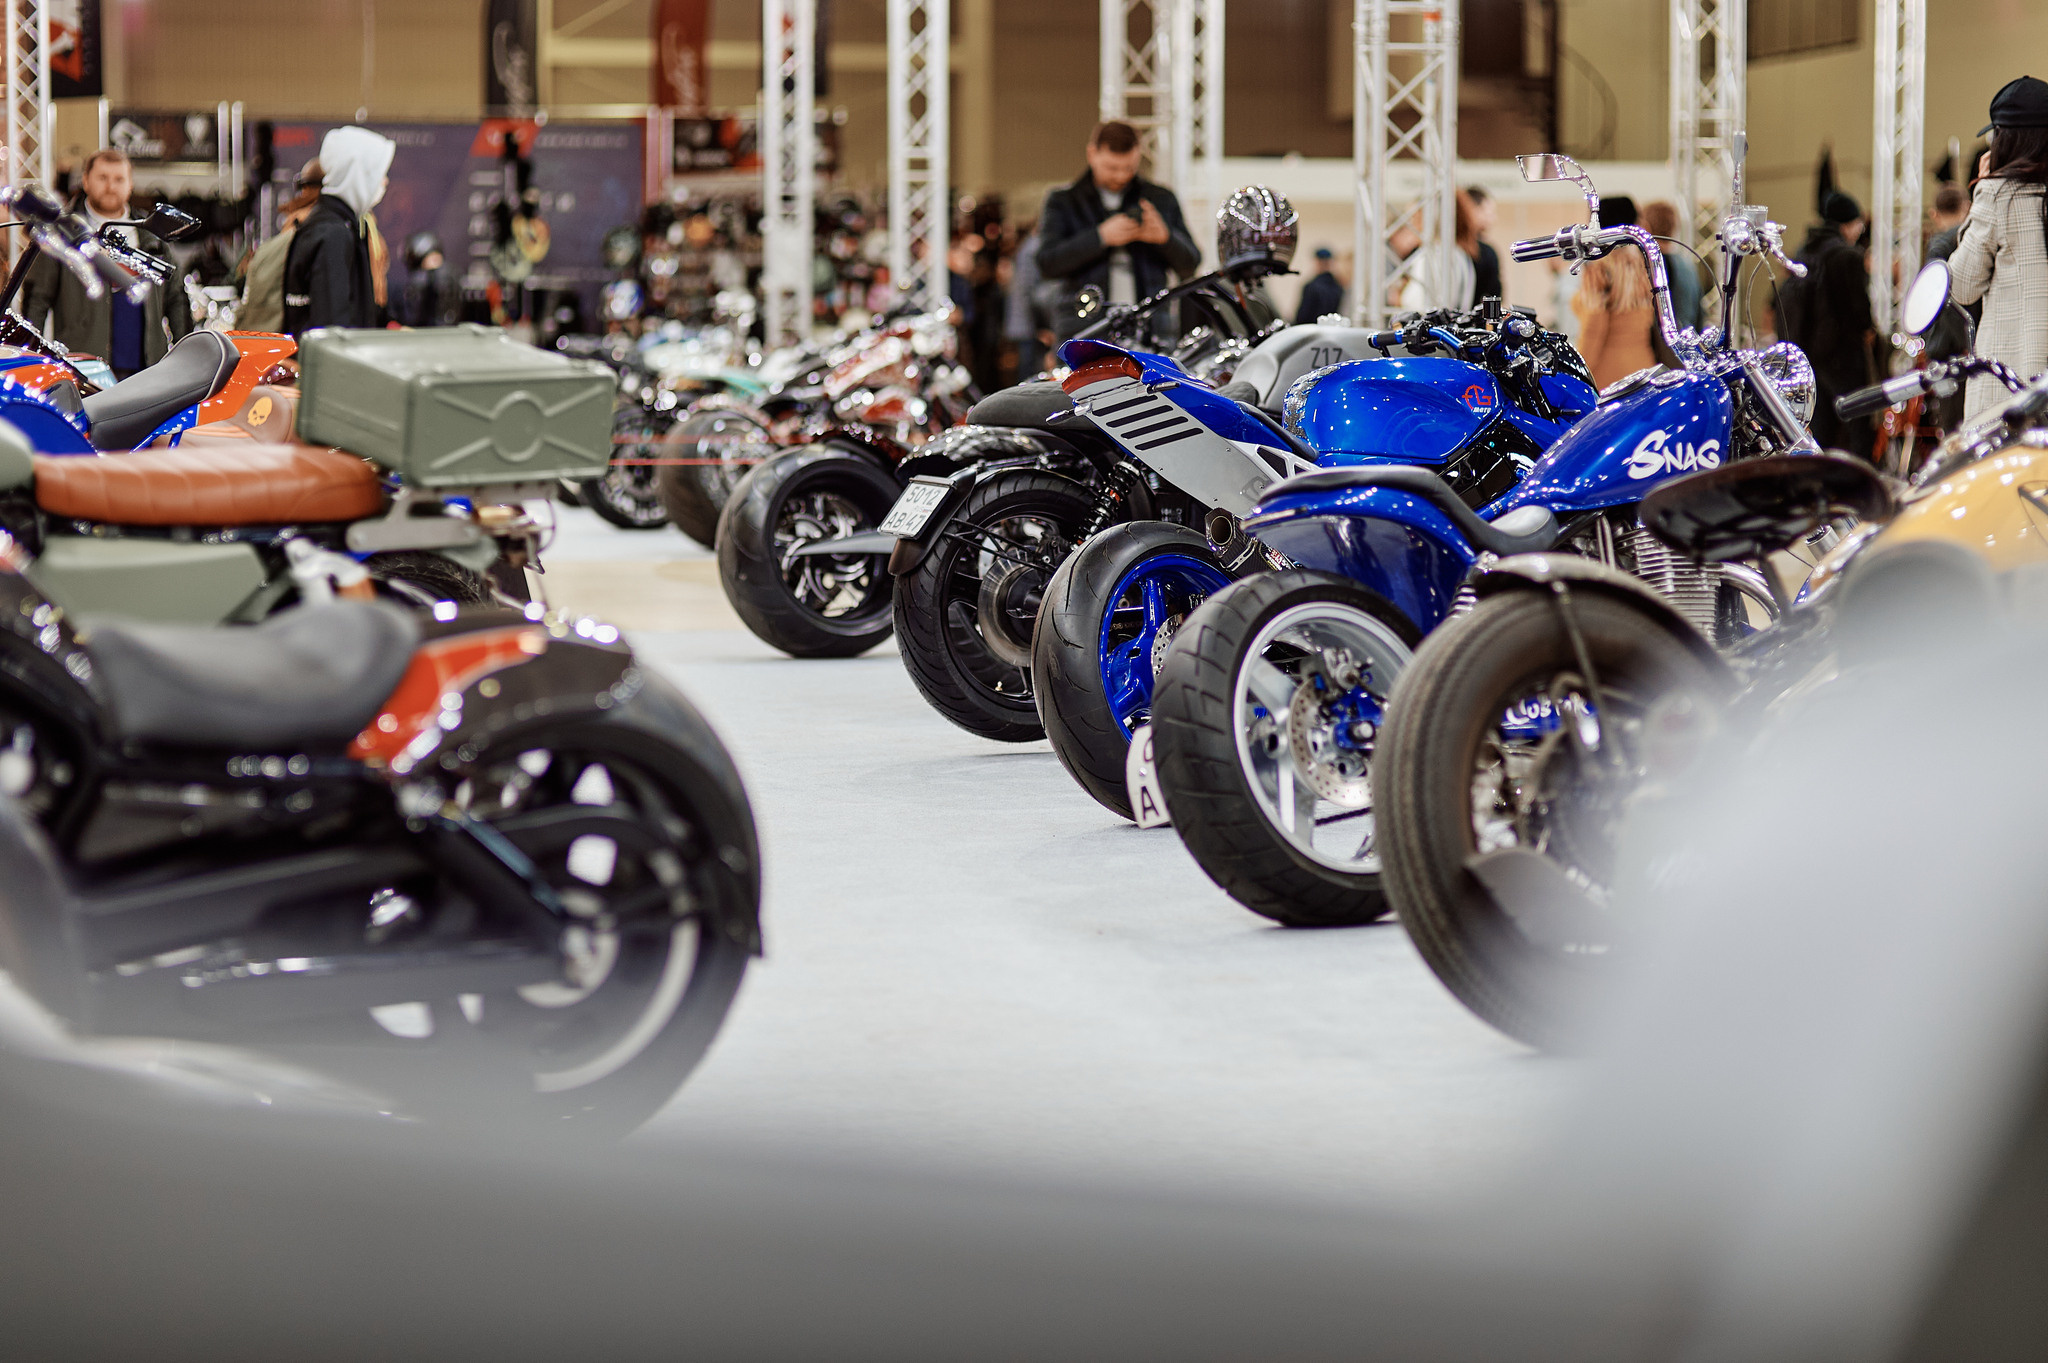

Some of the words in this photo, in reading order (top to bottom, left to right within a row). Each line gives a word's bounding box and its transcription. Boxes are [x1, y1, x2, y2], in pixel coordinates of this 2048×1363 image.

[1627, 429, 1721, 480] SNAG
[905, 485, 942, 506] 5012
[883, 511, 908, 529] AB
[905, 513, 927, 532] 47
